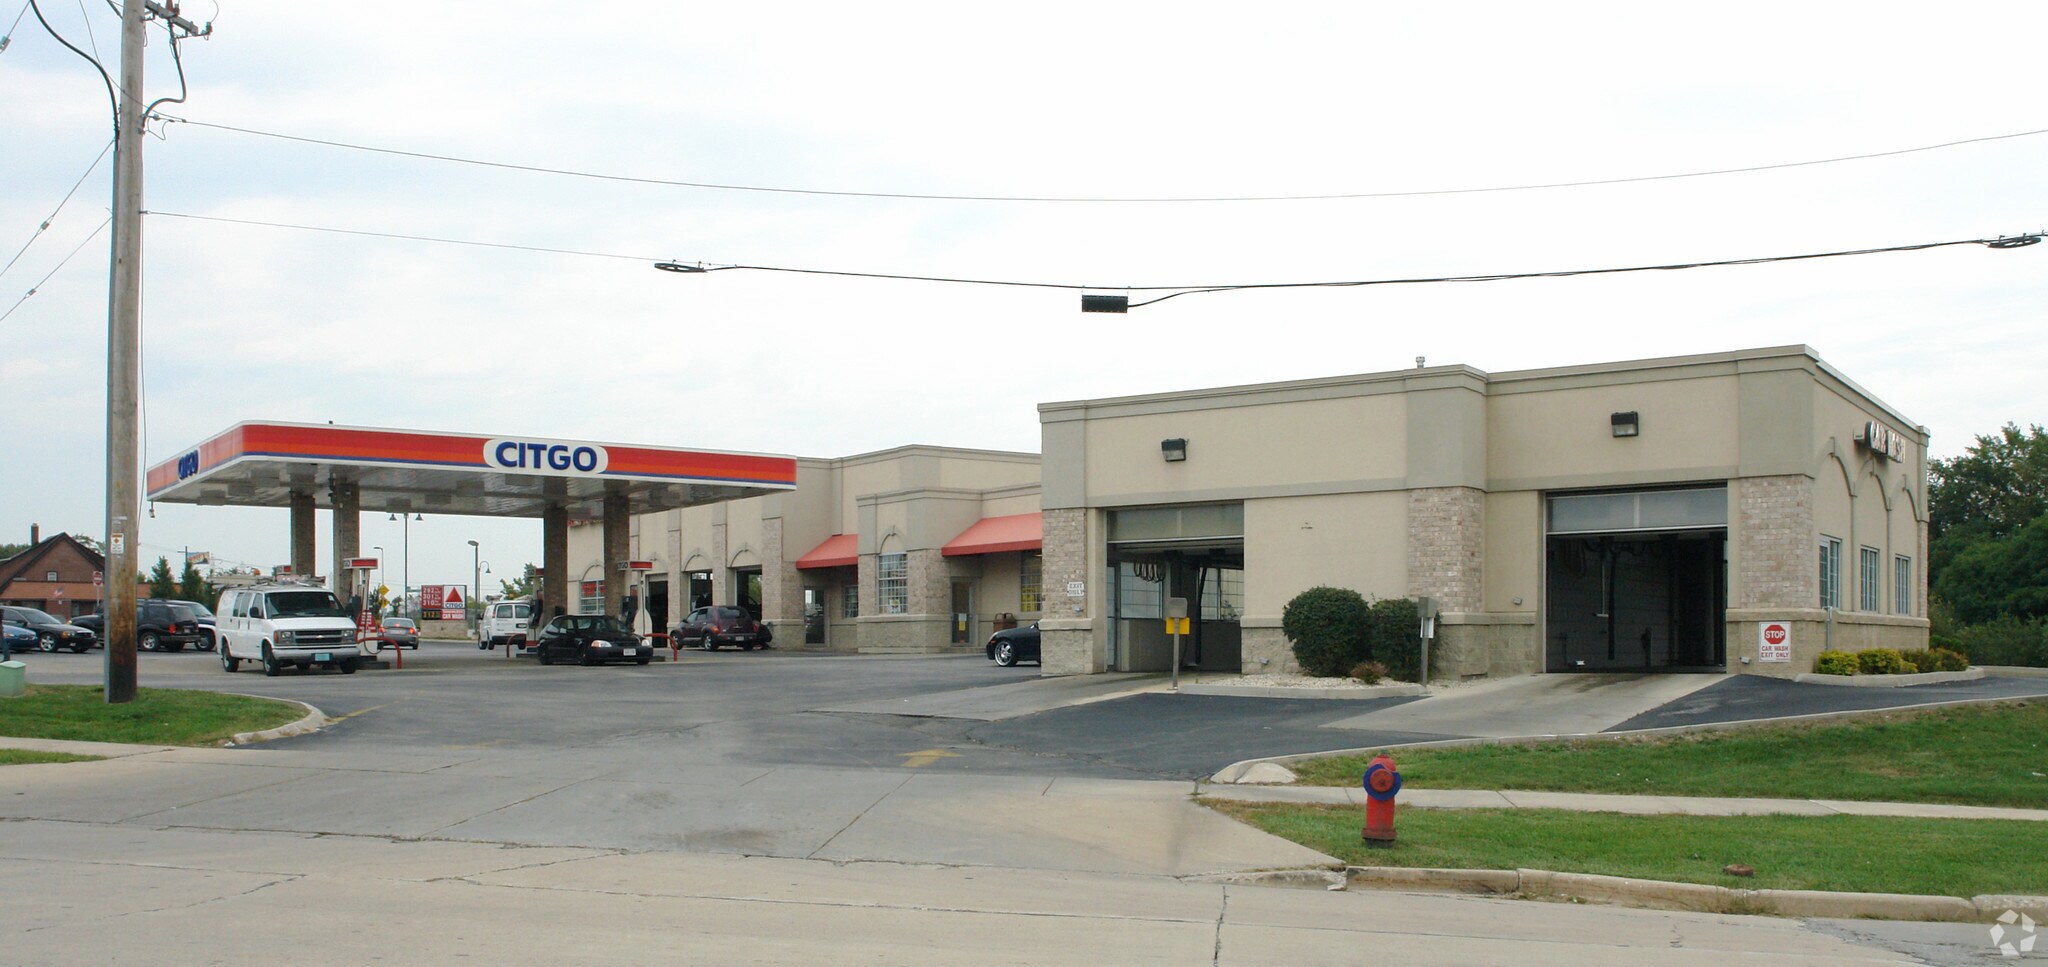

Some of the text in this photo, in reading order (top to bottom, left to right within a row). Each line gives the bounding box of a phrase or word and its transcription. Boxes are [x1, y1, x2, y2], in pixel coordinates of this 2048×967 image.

[495, 441, 597, 472] CITGO
[1868, 421, 1905, 463] CAR WASH
[1765, 630, 1785, 639] STOP
